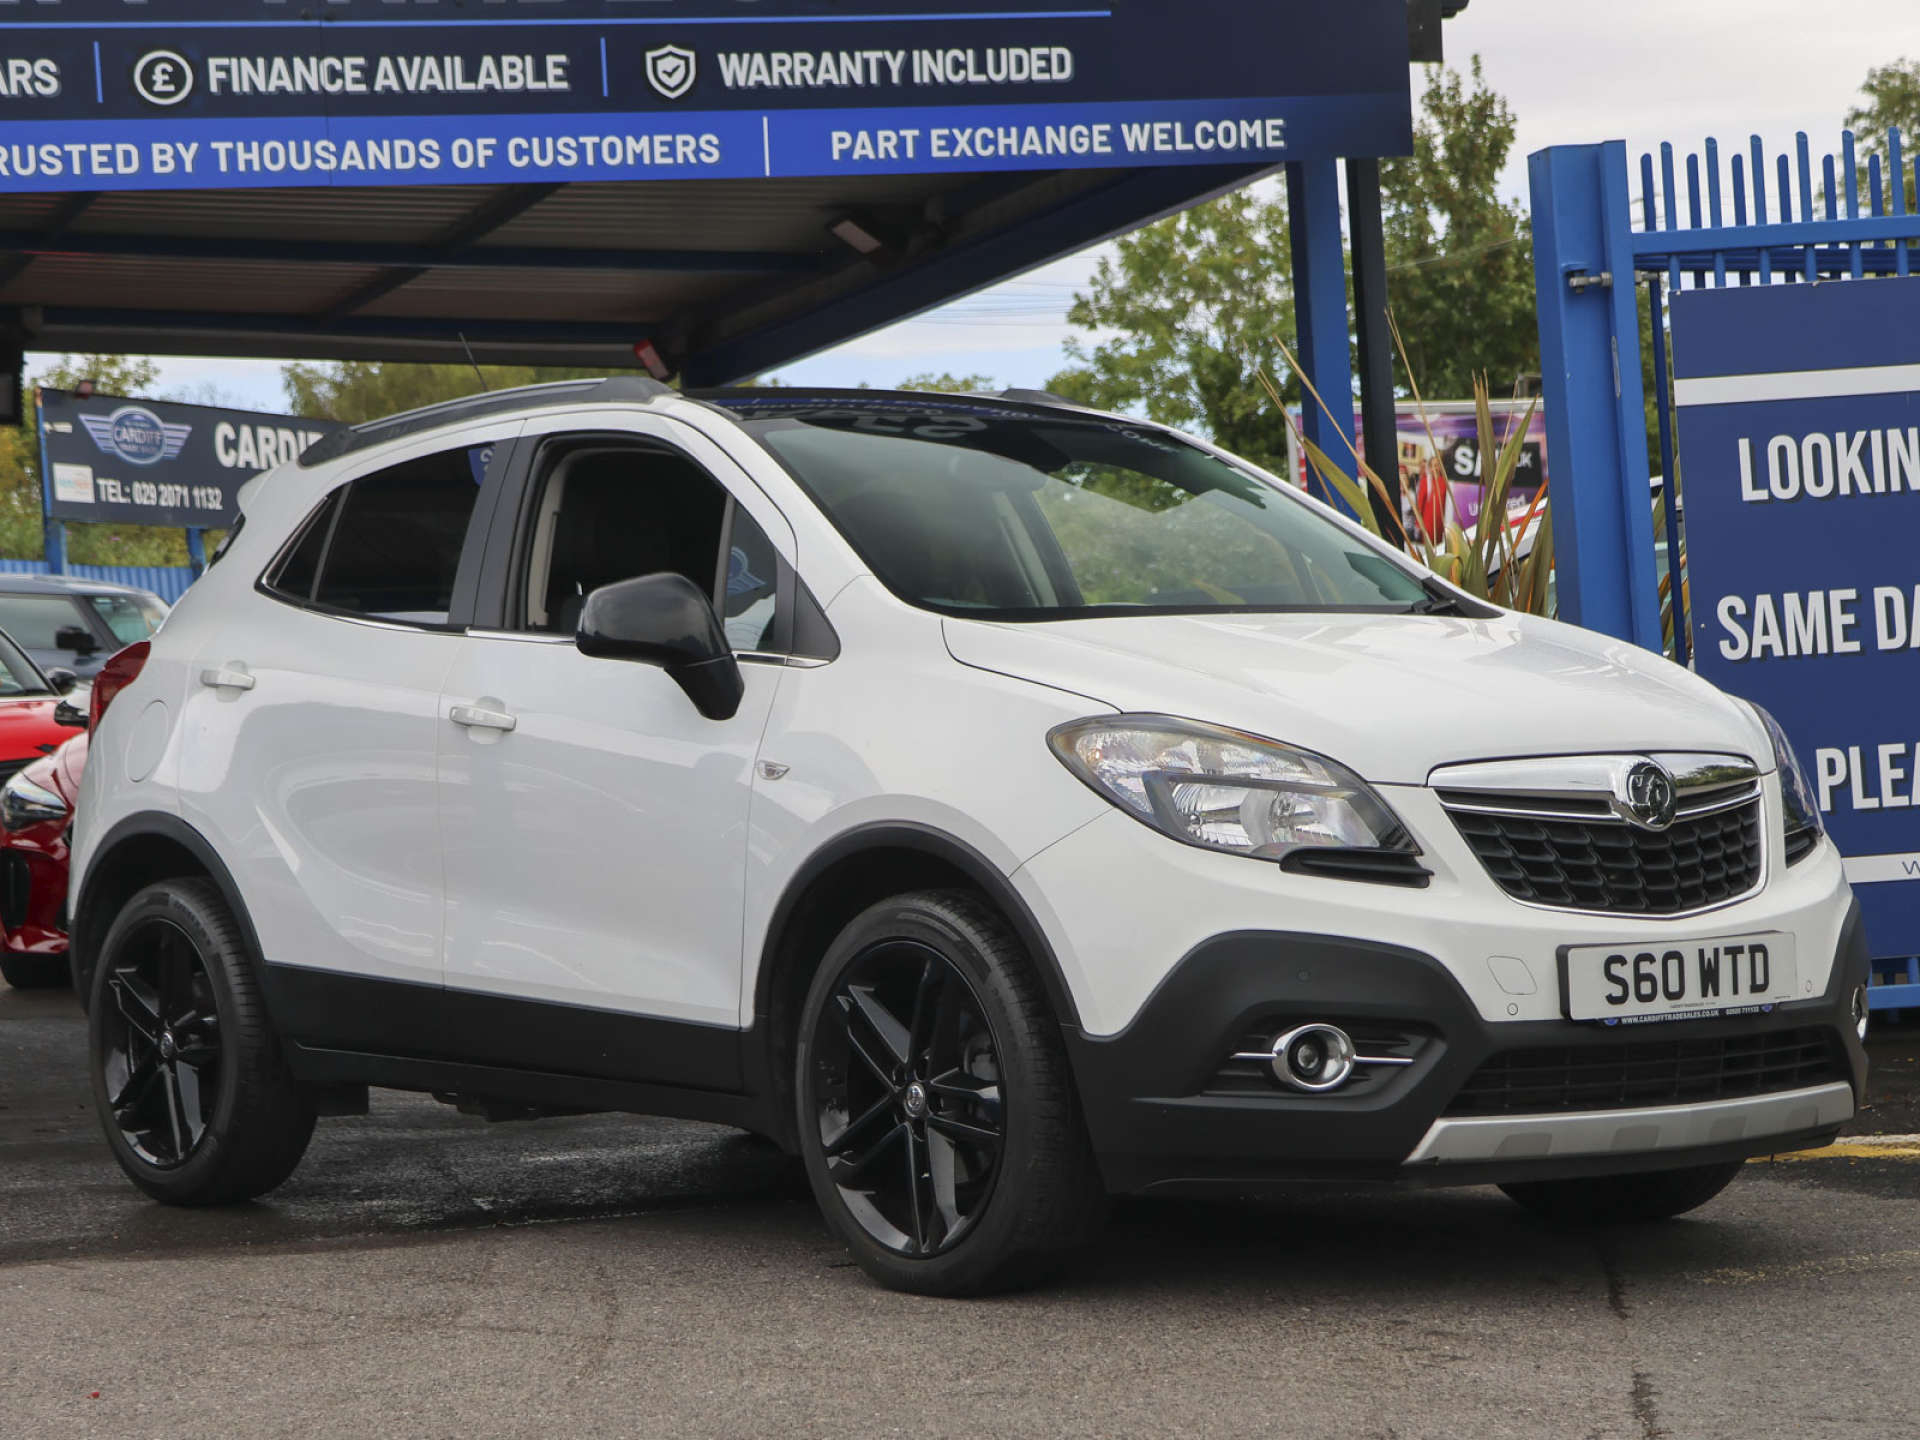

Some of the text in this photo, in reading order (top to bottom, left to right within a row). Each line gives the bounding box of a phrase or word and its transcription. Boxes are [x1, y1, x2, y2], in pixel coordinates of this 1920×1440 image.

[208, 54, 569, 92] FINANCE AVAILABLE
[717, 47, 1073, 87] WARRANTY INCLUDED
[152, 142, 199, 173] BY
[210, 139, 440, 171] THOUSANDS
[451, 138, 497, 168] OF
[507, 134, 721, 168] CUSTOMERS
[830, 119, 1285, 161] PART EXCHANGE WELCOME
[97, 478, 131, 504] TEL:
[132, 481, 157, 506] 029
[158, 483, 190, 509] 2071
[1716, 588, 1860, 661] SAME
[1815, 742, 1920, 812] PLE
[1603, 943, 1770, 1006] S60 WTD
